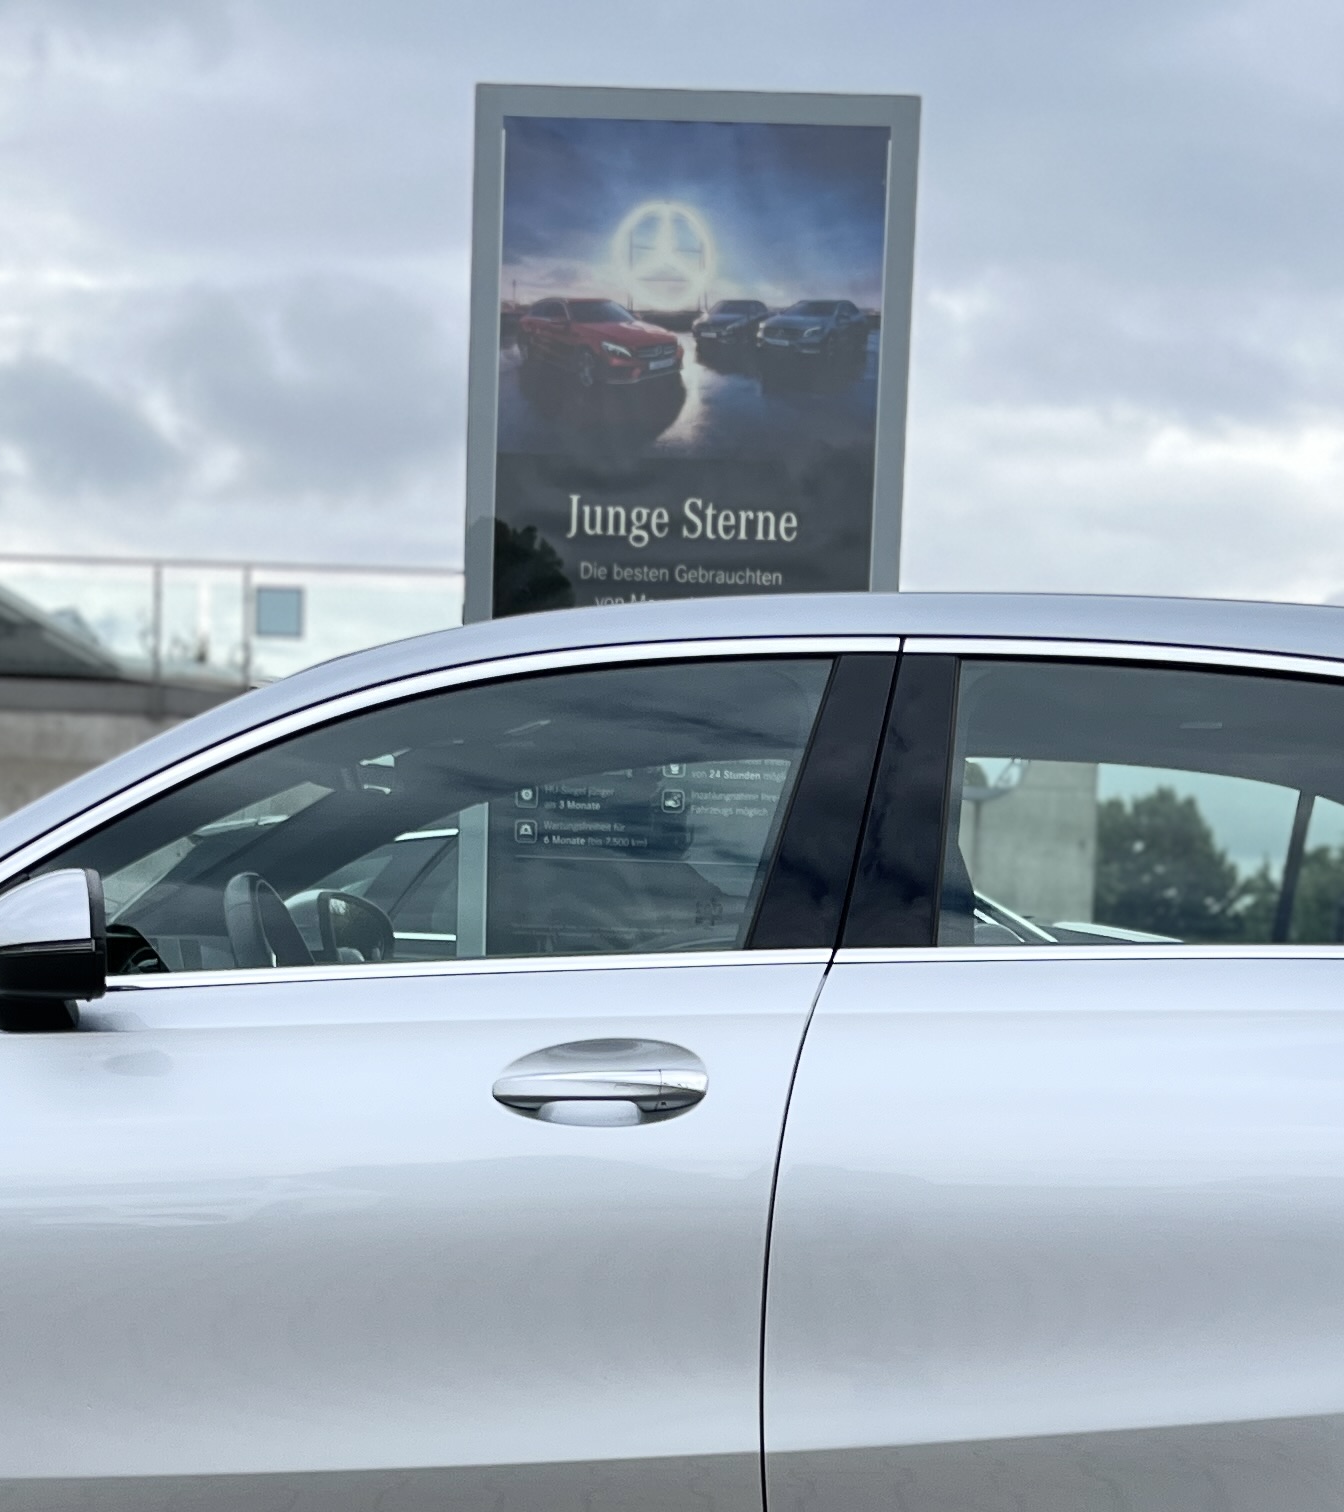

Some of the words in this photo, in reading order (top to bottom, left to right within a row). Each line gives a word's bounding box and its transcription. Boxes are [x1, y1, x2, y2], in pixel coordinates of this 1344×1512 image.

[566, 494, 669, 547] Junge
[682, 497, 798, 542] Sterne
[580, 560, 607, 580] Die
[613, 562, 669, 582] besten
[675, 563, 782, 586] Gebrauchten
[709, 769, 721, 779] 24
[723, 769, 761, 780] Stunden
[559, 799, 565, 810] 3
[566, 799, 601, 811] Monate
[543, 835, 550, 845] 6
[552, 835, 586, 846] Monate
